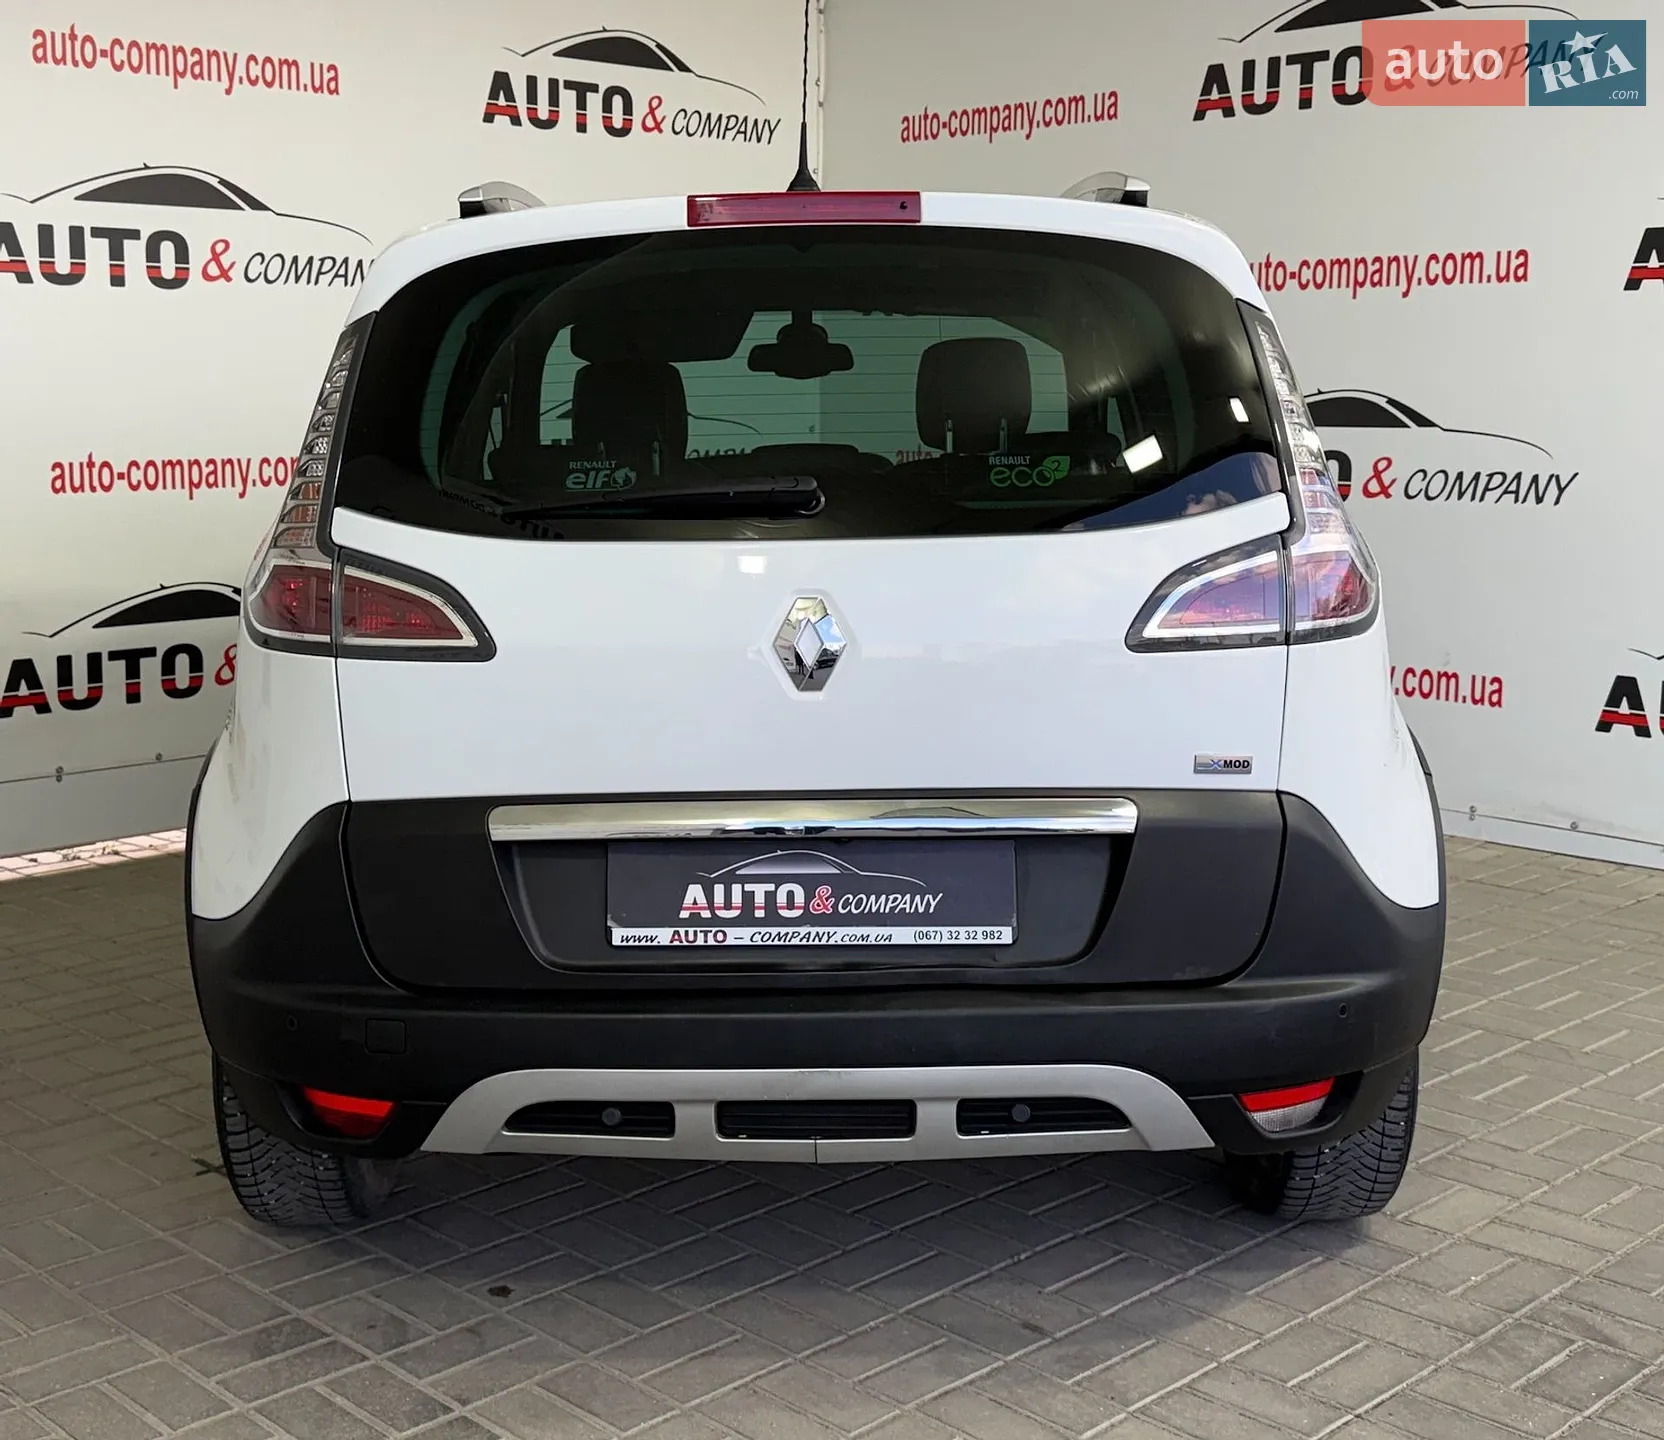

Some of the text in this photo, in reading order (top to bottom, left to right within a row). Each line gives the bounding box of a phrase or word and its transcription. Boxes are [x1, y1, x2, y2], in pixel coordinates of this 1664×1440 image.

[32, 23, 340, 96] auto-company.com.ua
[1193, 45, 1374, 121] AUTO
[482, 70, 781, 145] AUTO & COMPANY
[900, 90, 1119, 144] auto-company.com.ua
[0, 222, 190, 290] AUTO
[201, 238, 236, 284] &
[569, 461, 617, 469] RENAULT
[989, 456, 1030, 465] RENAULT
[1362, 457, 1397, 499] &
[1404, 468, 1578, 506] COMPANY
[0, 643, 204, 718] AUTO
[678, 883, 943, 918] AUTO & COMPANY
[669, 929, 728, 944] AUTO
[913, 930, 943, 942] (067)
[947, 930, 961, 940] 32
[964, 930, 978, 940] 32
[981, 930, 1003, 941] 982
